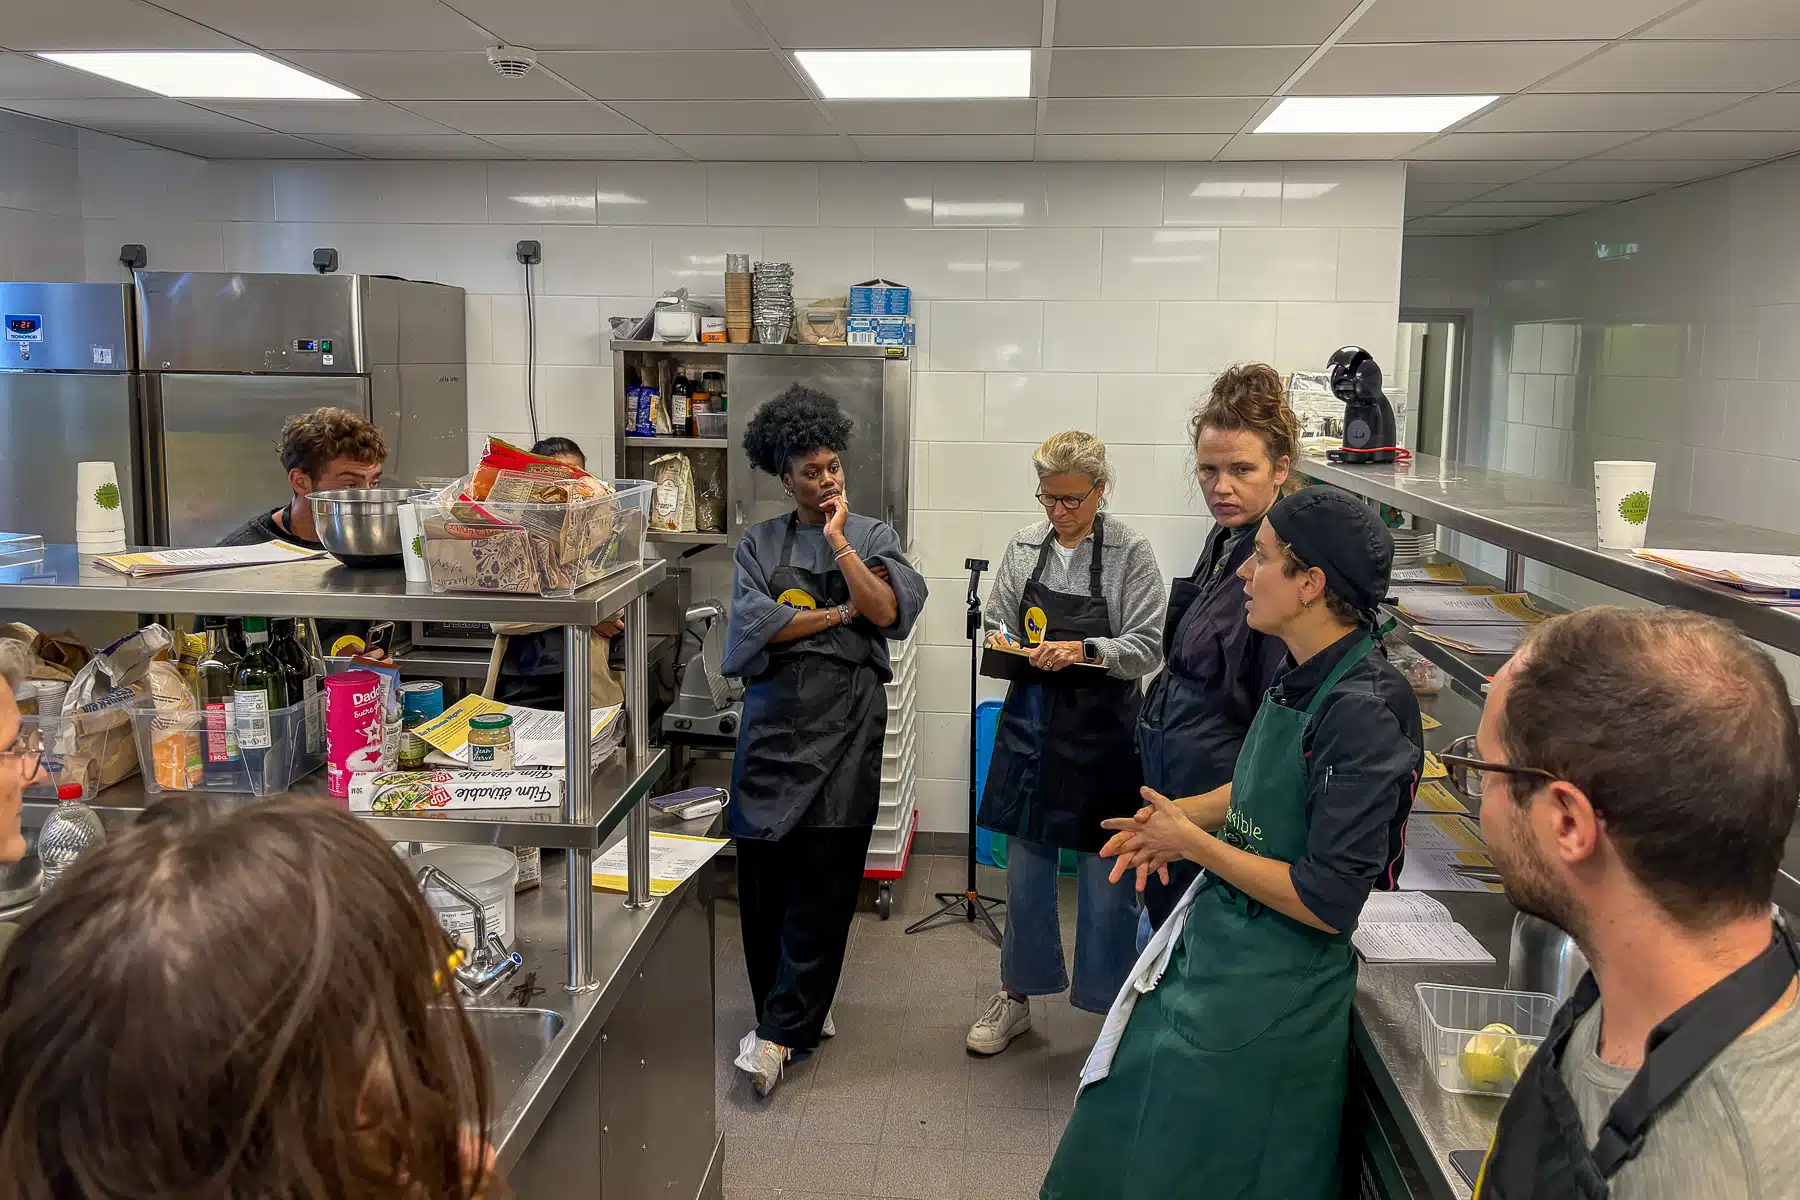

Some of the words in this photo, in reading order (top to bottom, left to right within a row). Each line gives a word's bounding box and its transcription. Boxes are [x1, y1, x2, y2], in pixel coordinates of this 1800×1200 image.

[352, 684, 381, 706] Dadd
[354, 705, 374, 719] Sucre
[473, 753, 493, 761] Hervé
[430, 791, 450, 805] TOP
[455, 786, 512, 802] étirable
[515, 785, 552, 803] Film
